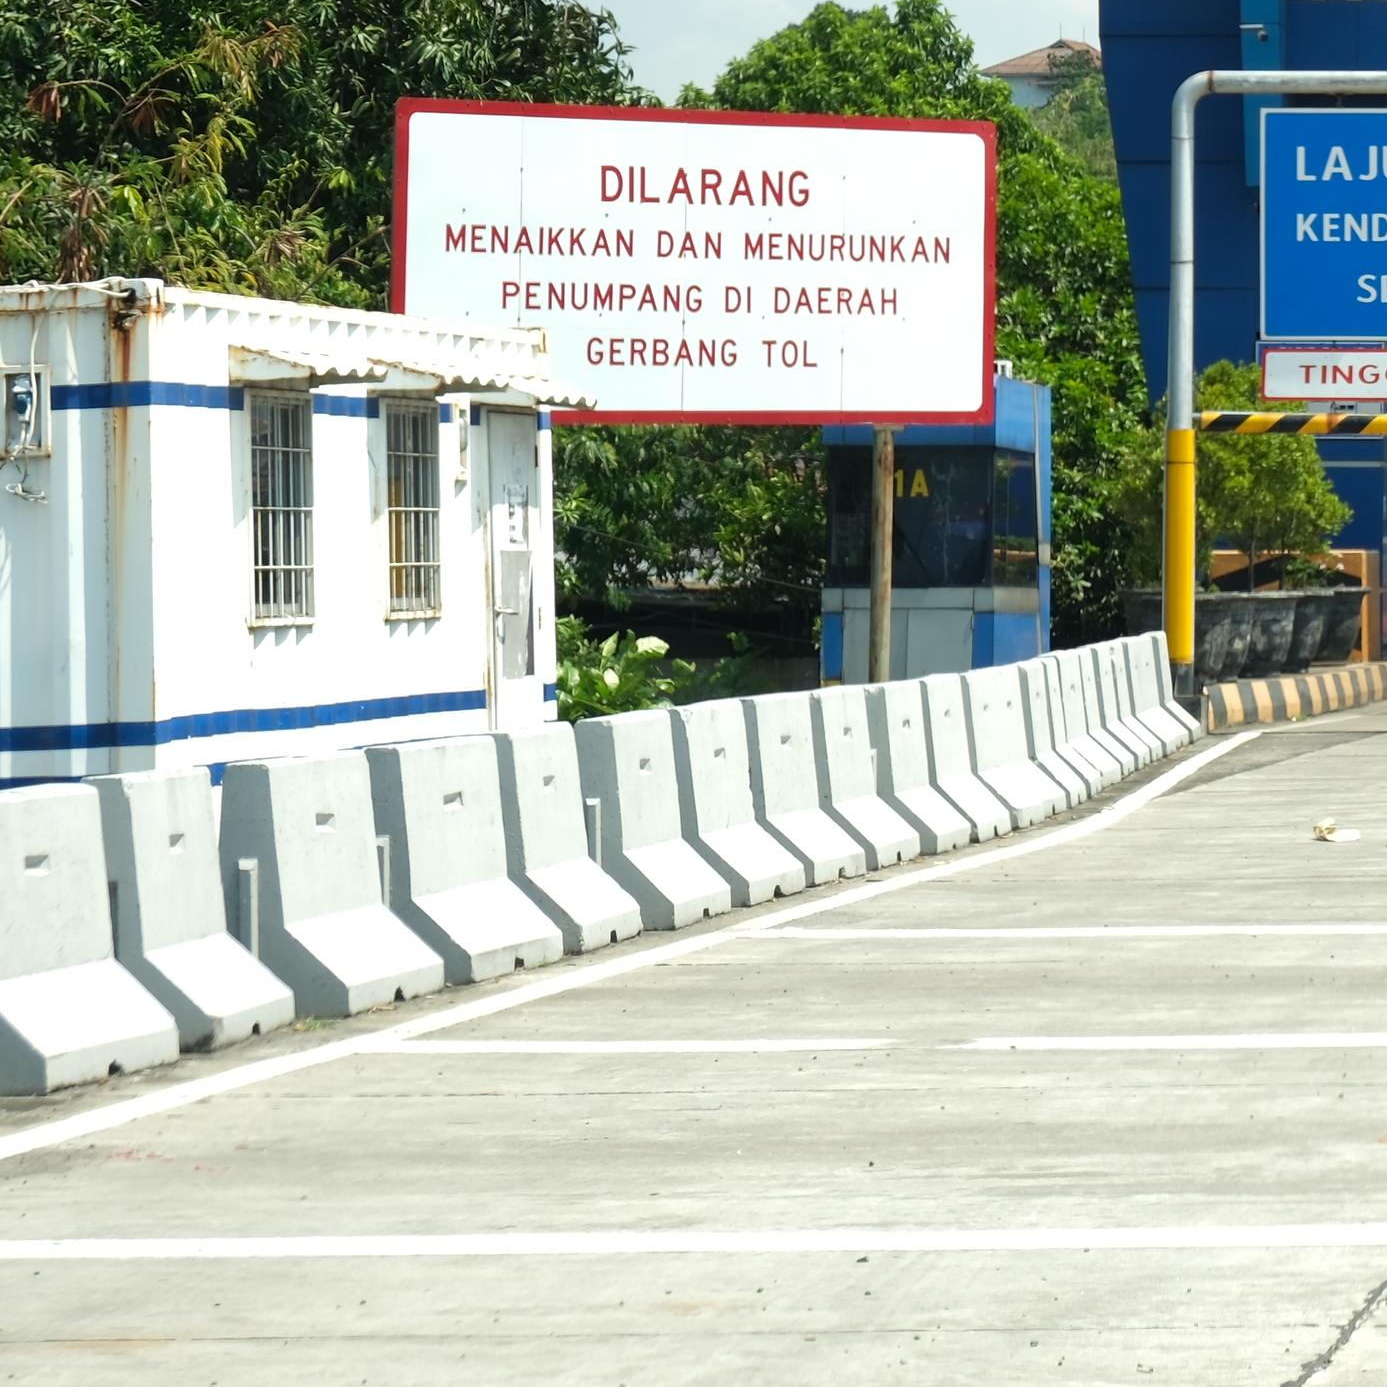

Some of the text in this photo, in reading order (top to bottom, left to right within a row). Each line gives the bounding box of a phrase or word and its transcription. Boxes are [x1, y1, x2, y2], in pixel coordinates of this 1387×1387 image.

[600, 165, 811, 207] DILARANG
[445, 224, 951, 264] MENAIKKAN DAN MENURUNKAN
[501, 281, 898, 315] PENUMPANG DI DAERAH
[586, 338, 818, 368] GERBANG TOL
